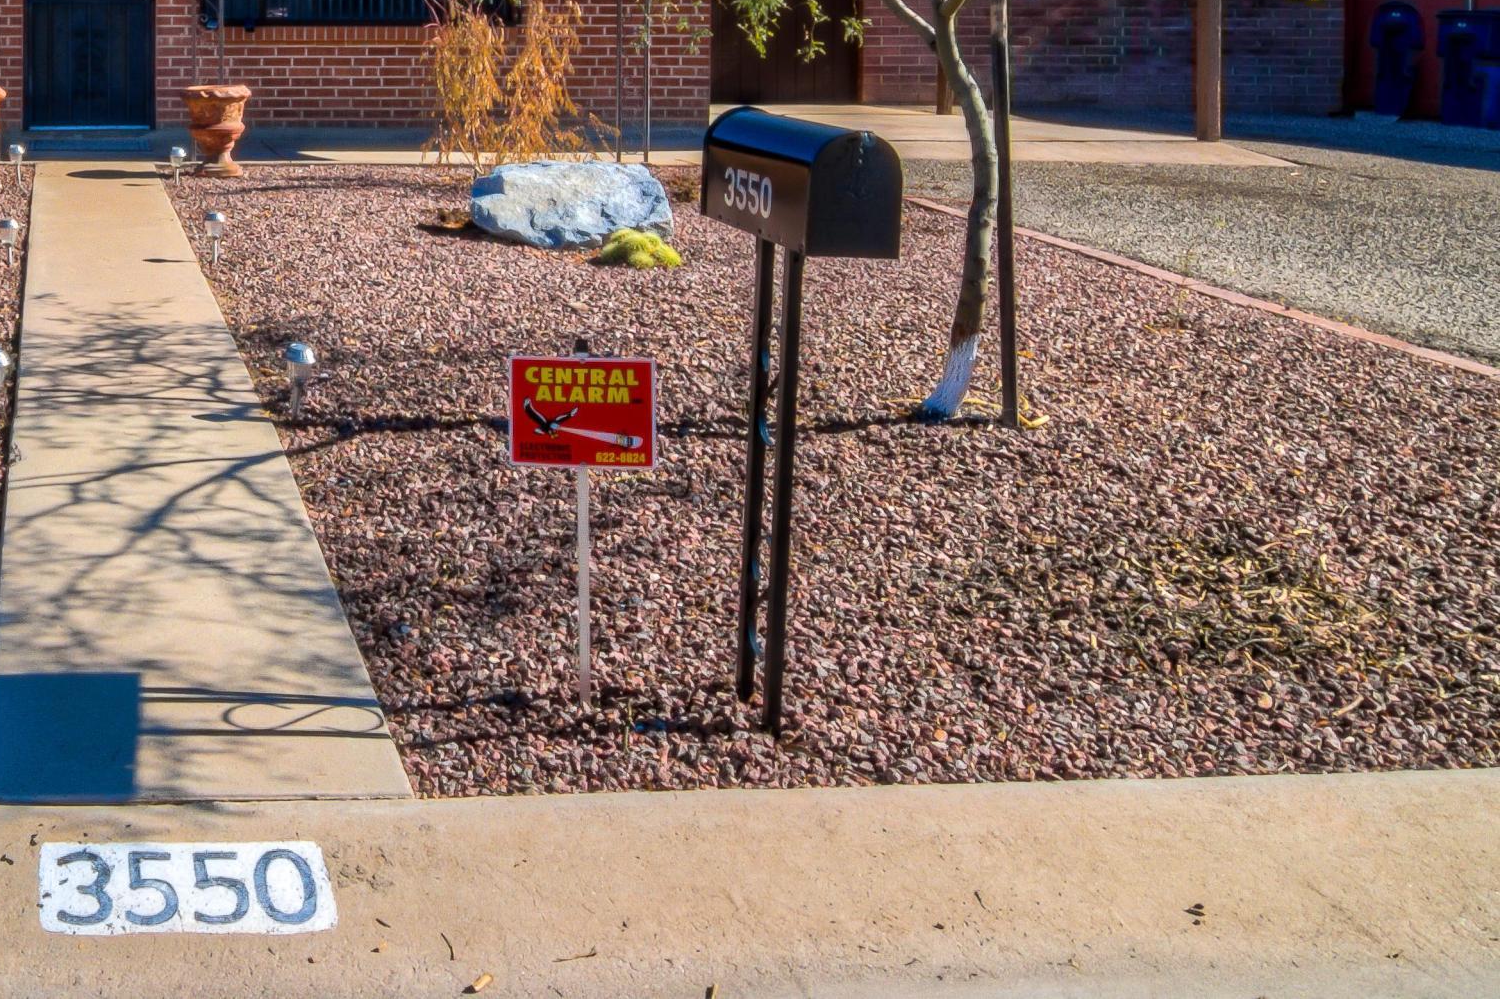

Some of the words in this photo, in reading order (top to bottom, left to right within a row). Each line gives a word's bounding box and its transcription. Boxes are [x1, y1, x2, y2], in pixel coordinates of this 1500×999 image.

[724, 166, 773, 219] 3550
[525, 367, 639, 386] CENTRAL
[536, 386, 630, 403] ALARM
[56, 848, 317, 924] 3550
